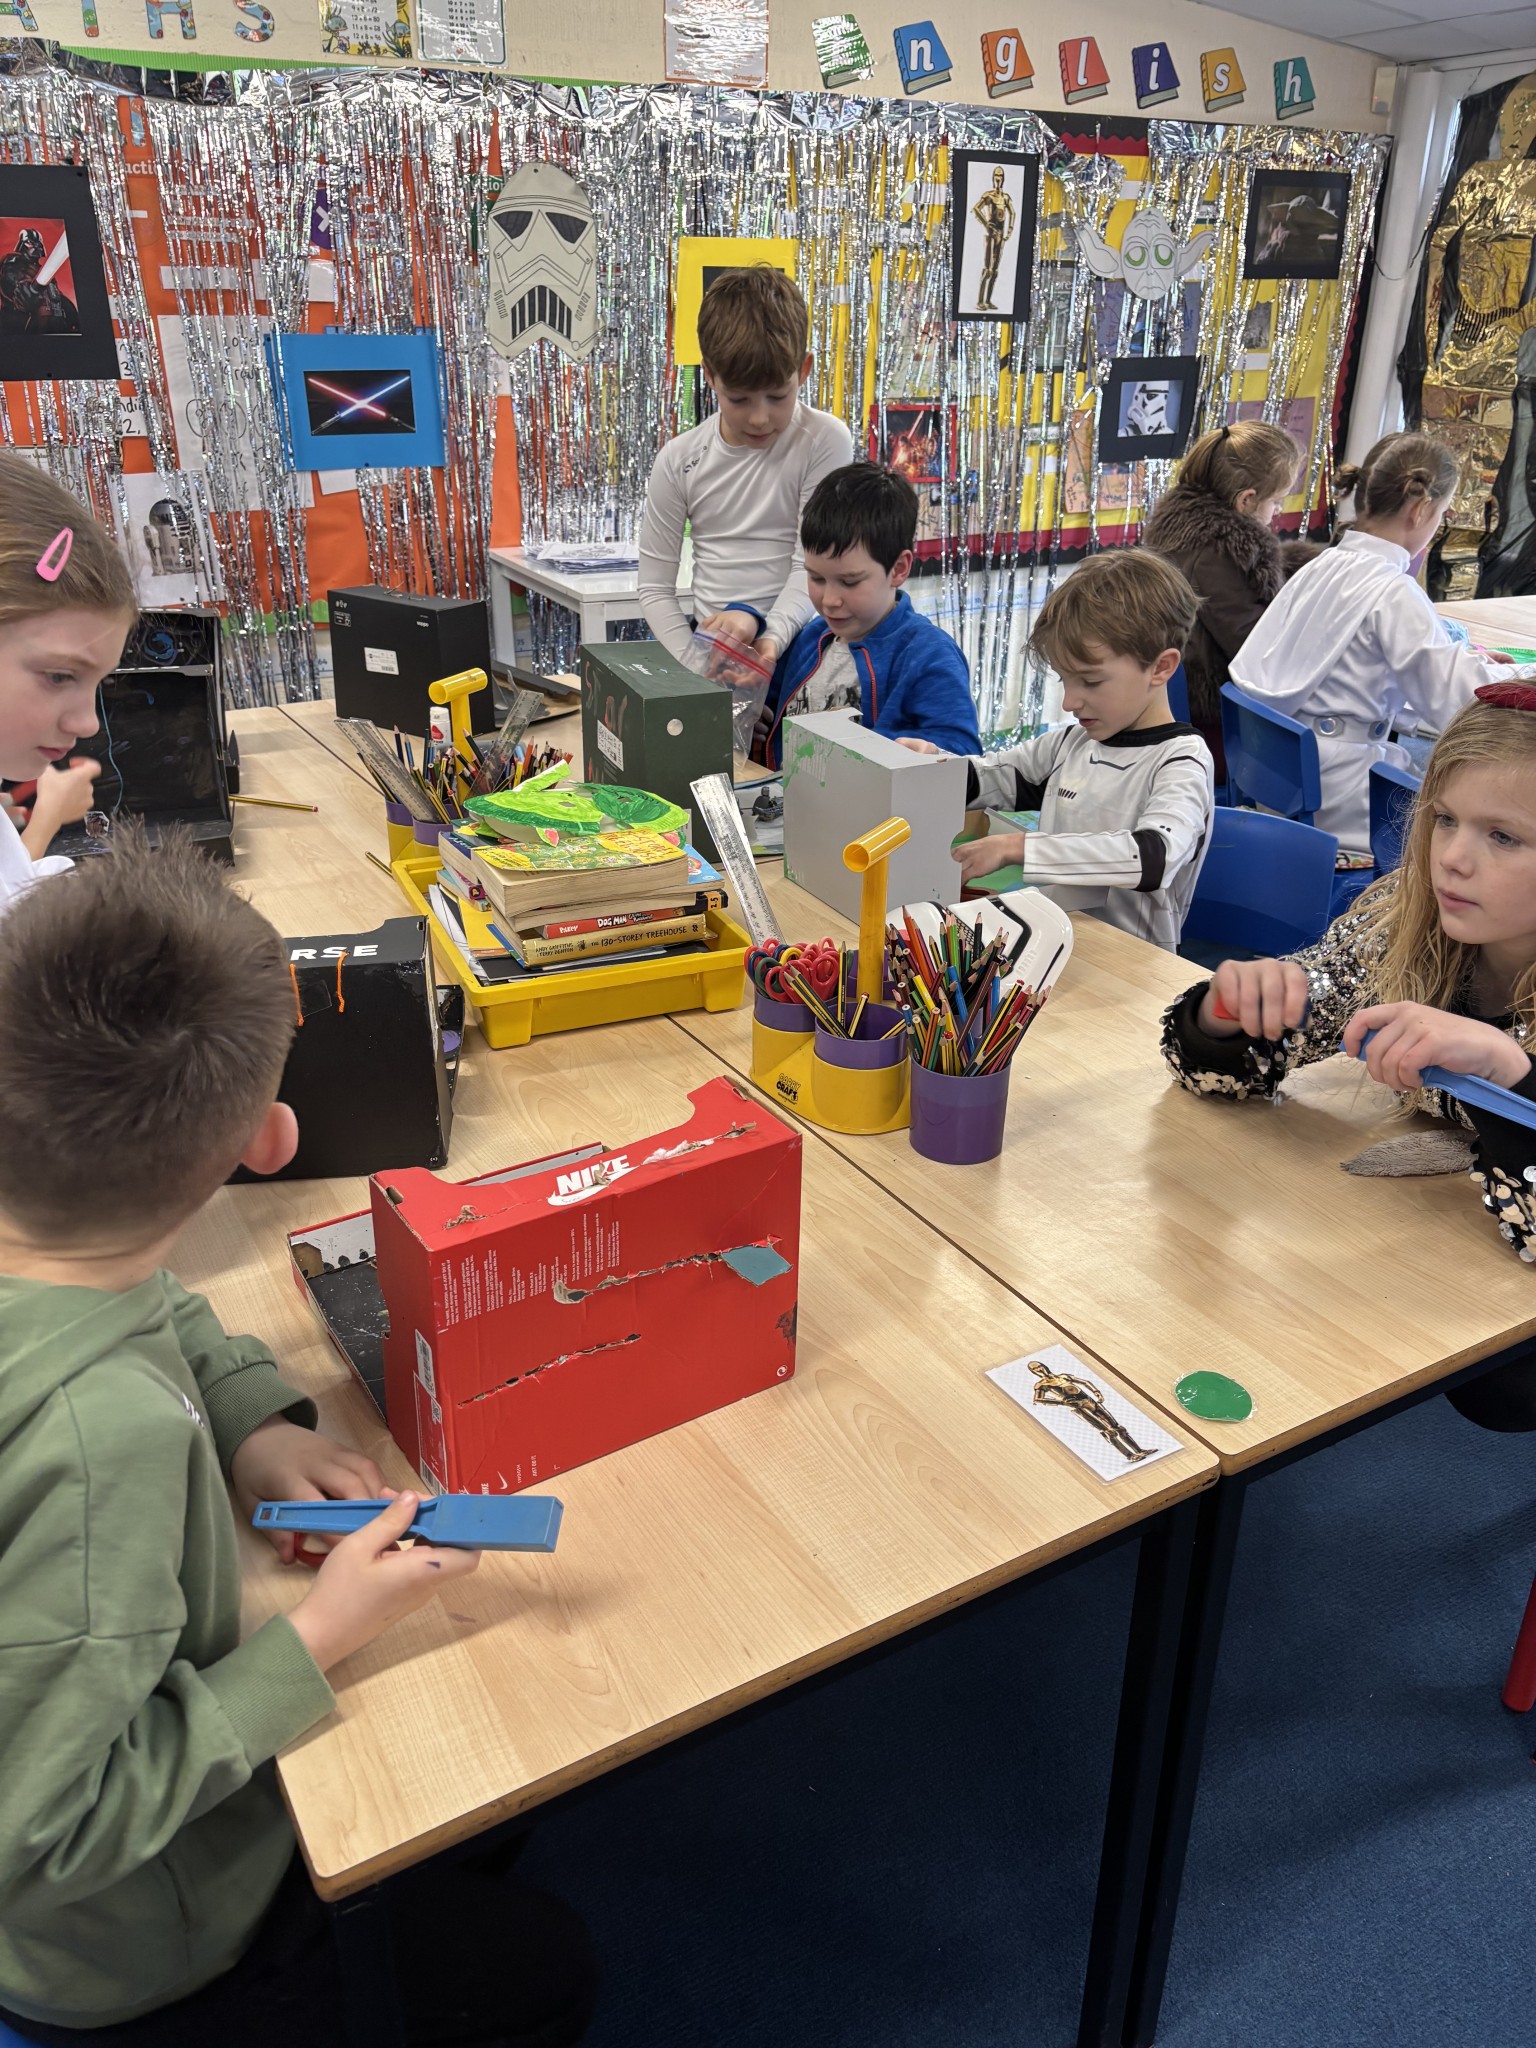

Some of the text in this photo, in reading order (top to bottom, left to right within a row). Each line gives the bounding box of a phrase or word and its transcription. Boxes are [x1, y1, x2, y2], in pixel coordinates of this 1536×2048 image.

[600, 932, 645, 947] 130-STOREY
[645, 926, 688, 940] TREEHOUSE
[775, 1080, 799, 1101] CRAFT
[556, 1154, 630, 1196] NIKE
